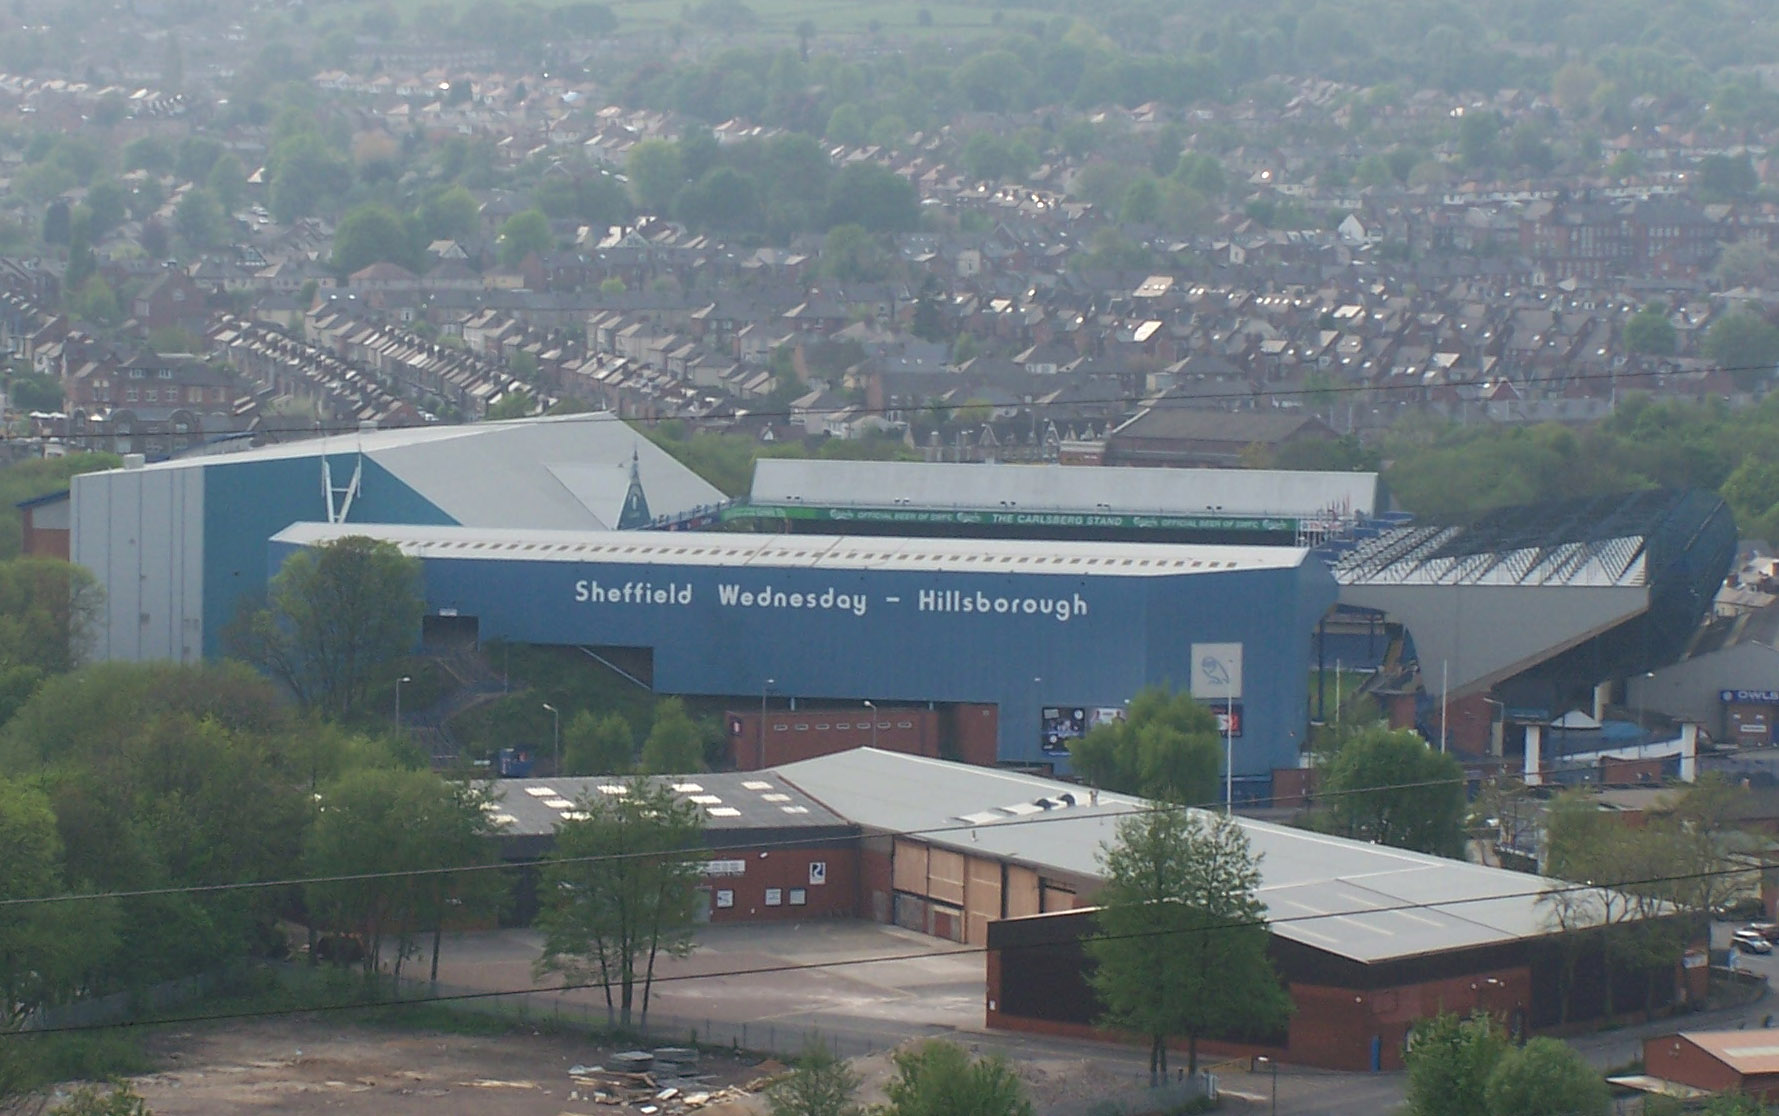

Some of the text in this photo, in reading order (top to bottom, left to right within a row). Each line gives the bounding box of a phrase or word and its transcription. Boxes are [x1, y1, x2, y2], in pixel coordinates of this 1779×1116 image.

[992, 513, 1014, 523] THE
[1017, 514, 1084, 525] CARLSBERG
[1086, 515, 1122, 526] STAND
[575, 579, 693, 604] Sheffield
[718, 583, 867, 616] Wednesday
[918, 589, 1088, 621] Hillsborough
